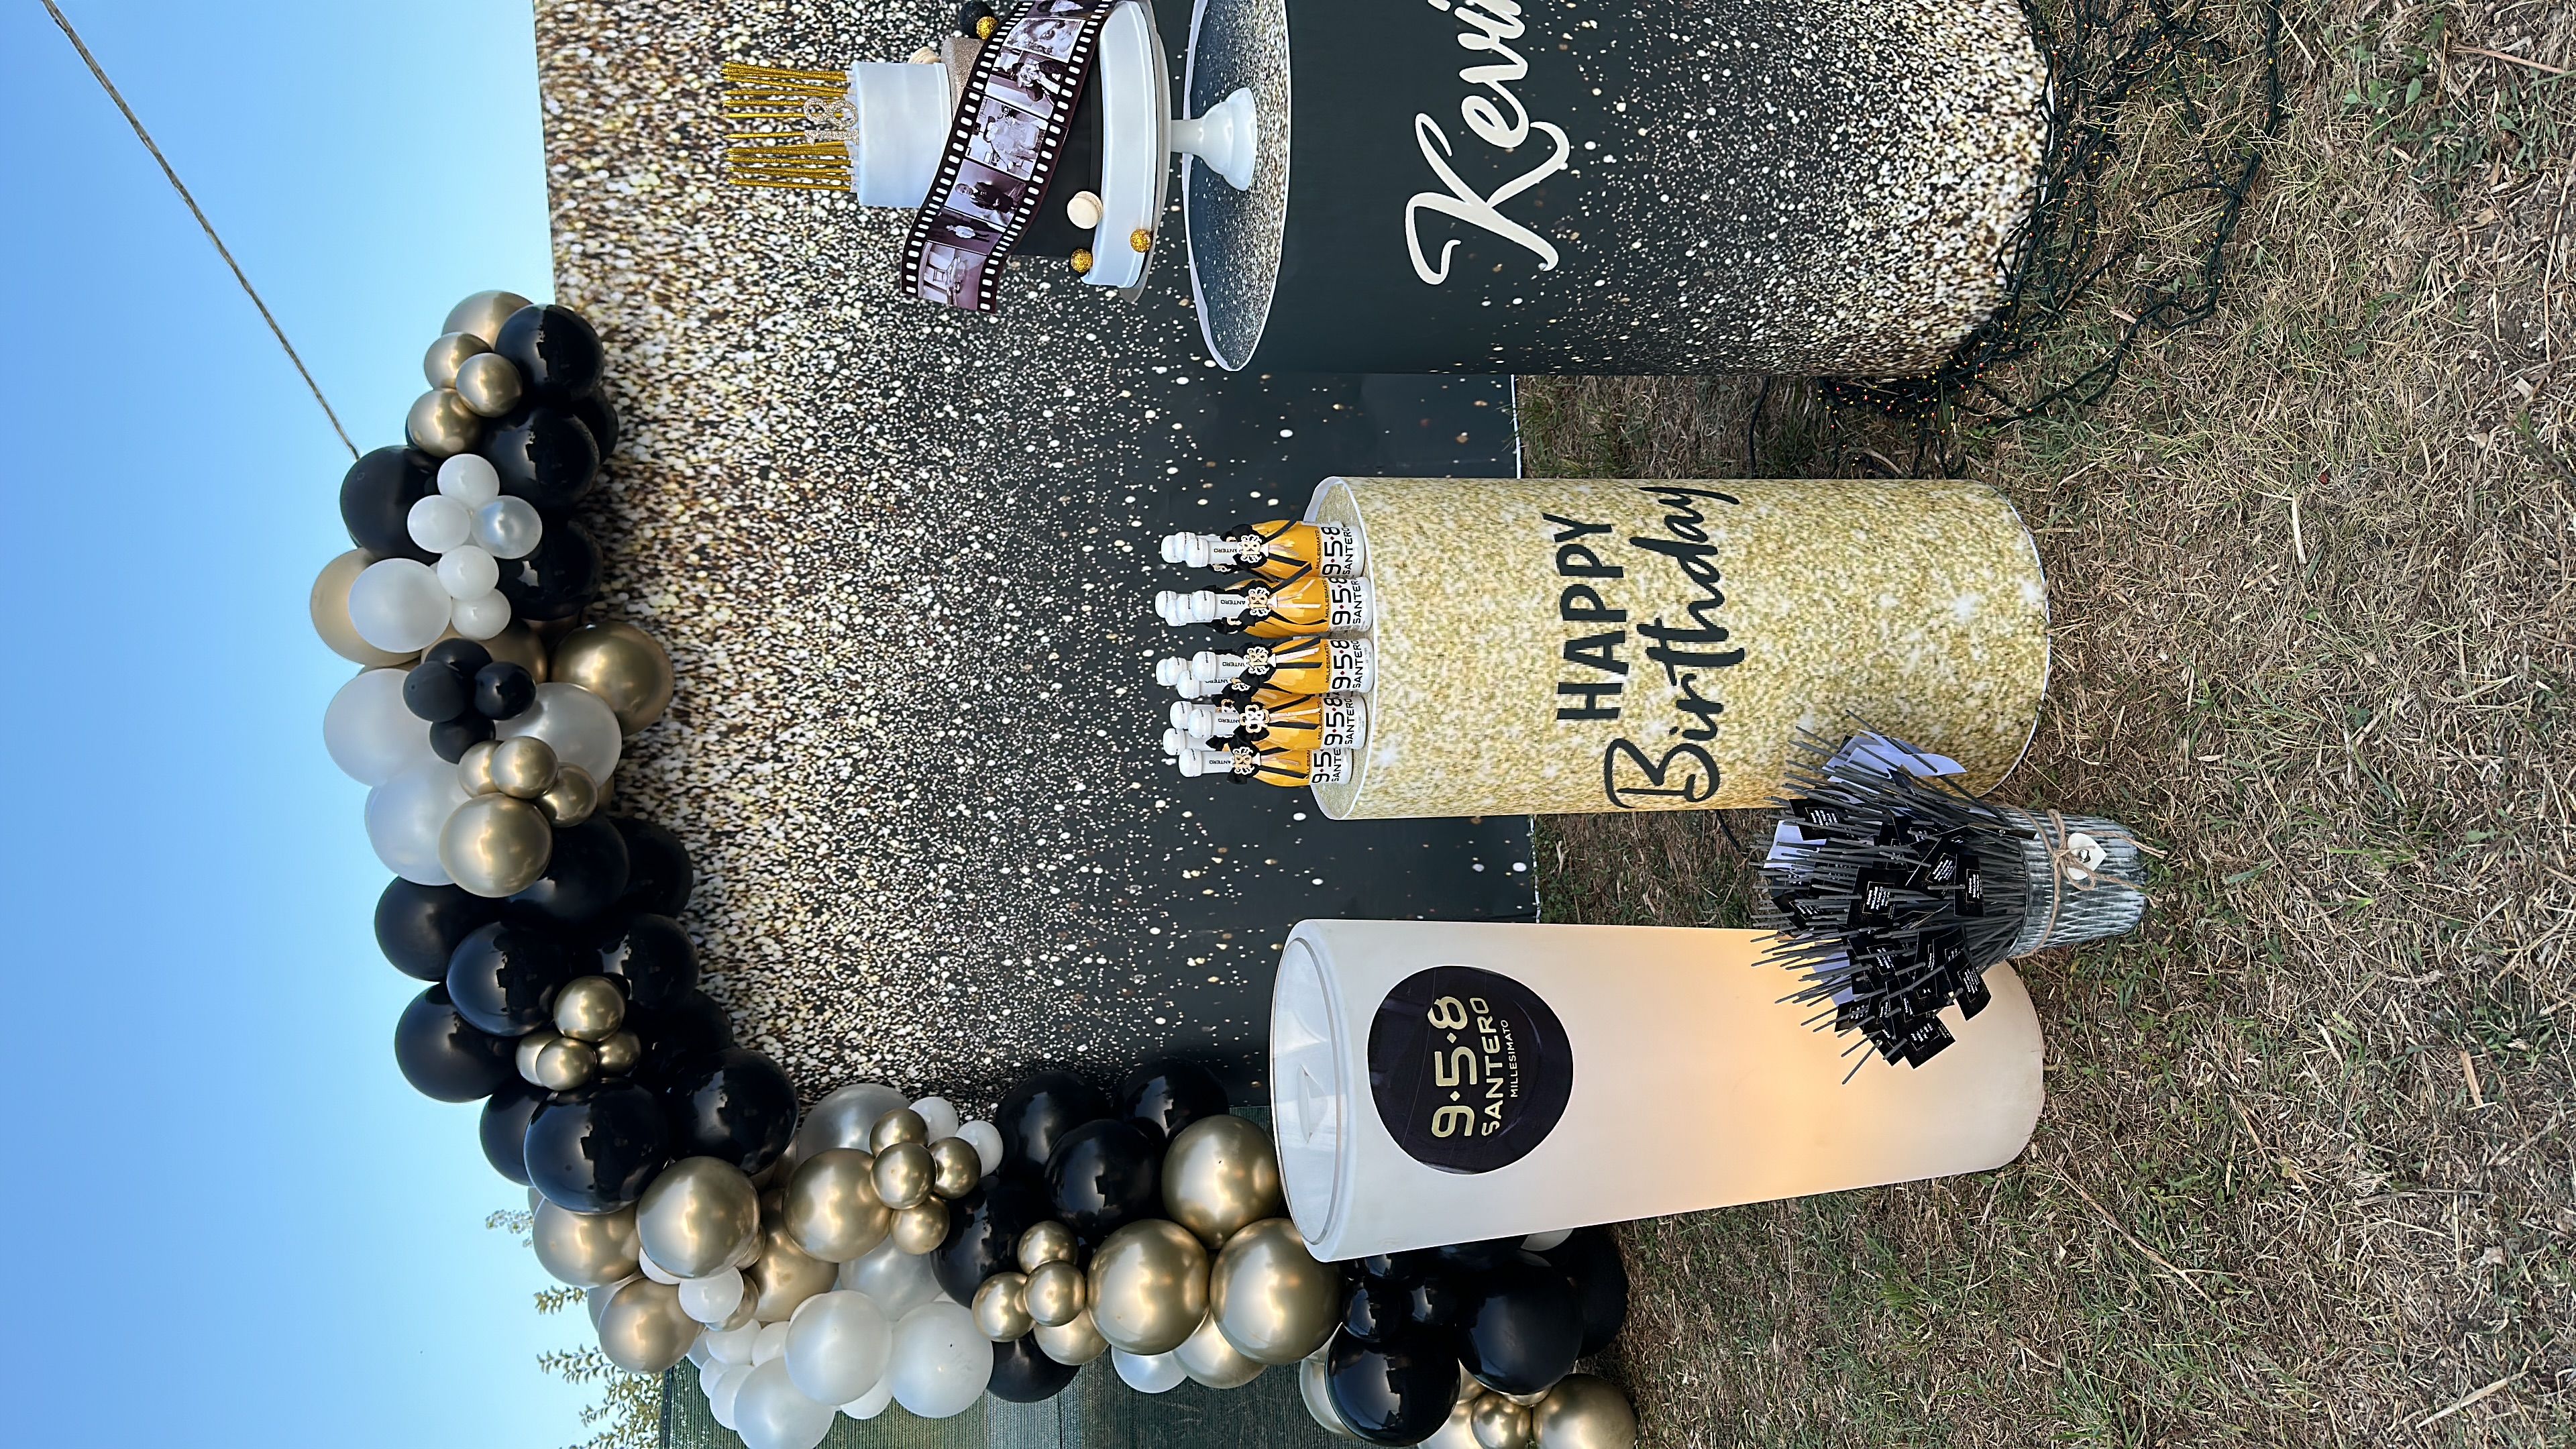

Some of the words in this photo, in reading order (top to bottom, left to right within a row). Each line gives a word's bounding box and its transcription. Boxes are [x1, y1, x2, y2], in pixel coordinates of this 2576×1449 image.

[804, 98, 859, 146] 18
[1405, 0, 1570, 284] Kevi
[1241, 541, 1260, 557] 18
[1341, 527, 1354, 575] SANTERO
[1248, 593, 1268, 609] 18
[1350, 579, 1362, 624] SANTER
[1542, 513, 1629, 720] HAPPY
[1248, 651, 1268, 669] 18
[1350, 640, 1363, 688] SANTERO
[1603, 486, 1745, 809] Birthday
[1344, 698, 1355, 745] SANTERO
[1332, 749, 1342, 782] SANTE
[1469, 997, 1504, 1136] SANTERO
[1500, 1019, 1518, 1097] MILLESIMATO
